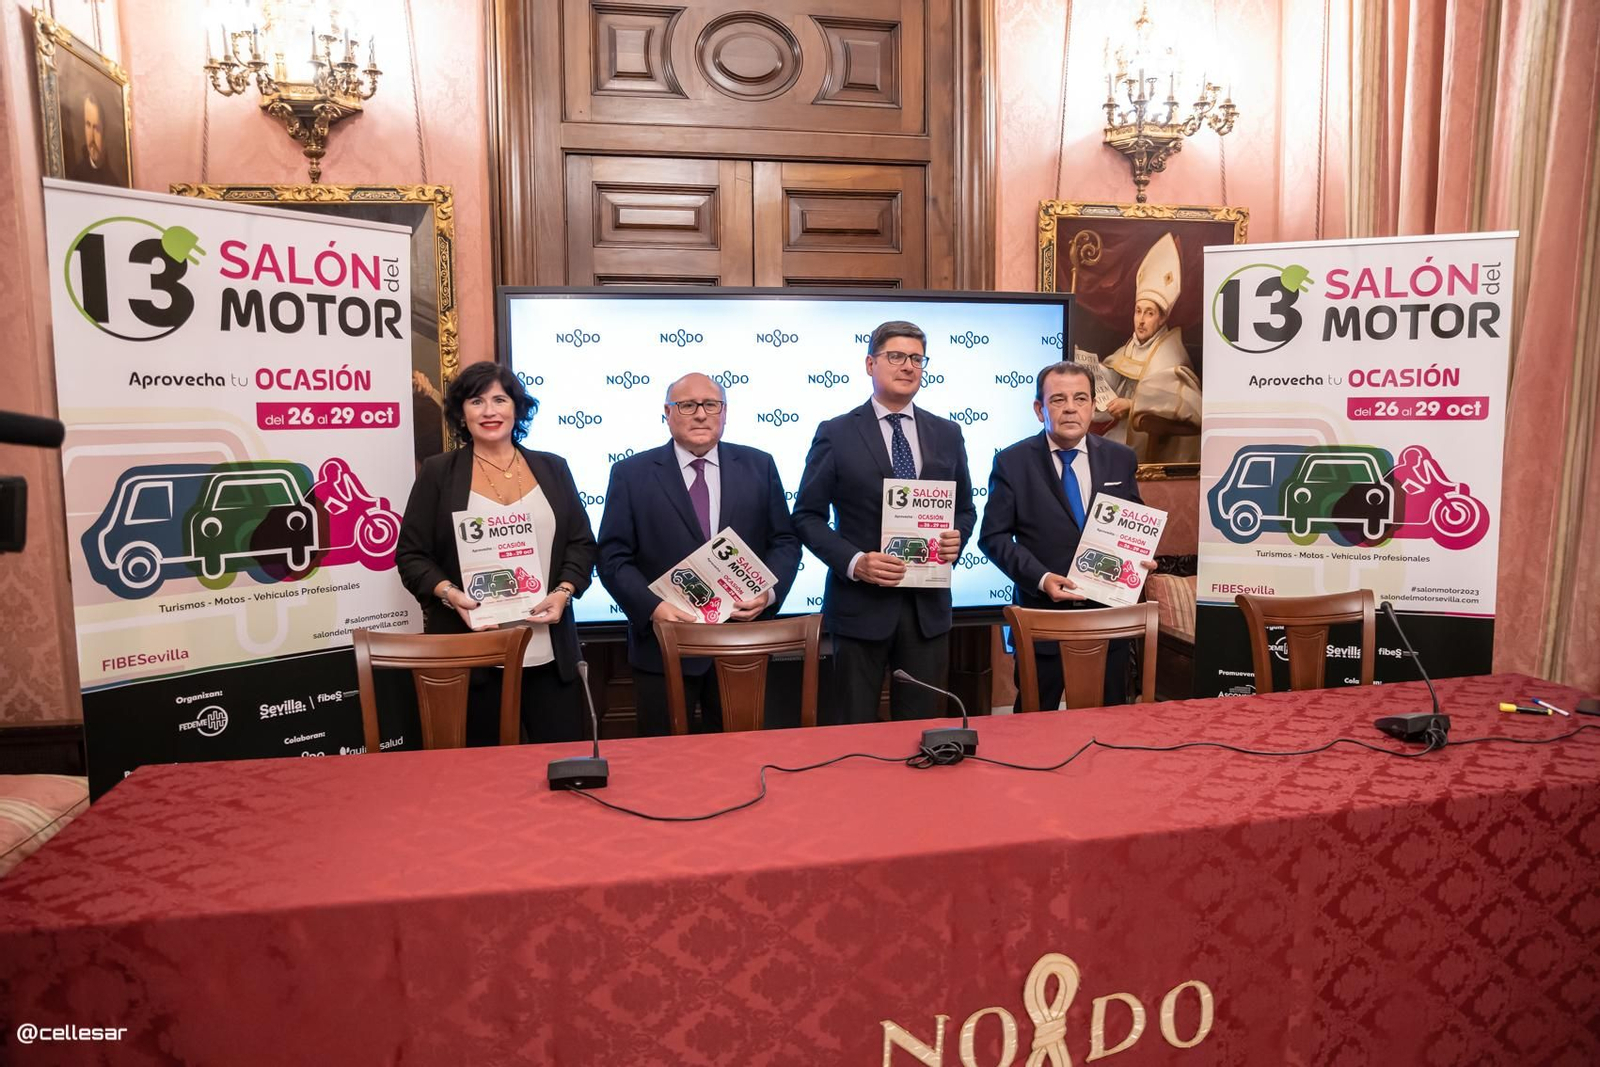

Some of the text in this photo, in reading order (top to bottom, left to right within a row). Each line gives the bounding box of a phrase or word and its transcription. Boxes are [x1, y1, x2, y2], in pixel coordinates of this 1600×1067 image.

[219, 240, 381, 290] SALÓN
[383, 257, 400, 293] del
[75, 233, 195, 327] 13
[1325, 256, 1479, 300] SALÓN
[1482, 261, 1501, 295] del
[220, 287, 403, 339] MOTOR
[1219, 276, 1303, 343] 13
[1322, 301, 1500, 341] MOTOR
[129, 363, 371, 391] Aprovecha tu OCASIÓN
[1249, 363, 1460, 388] Aprovecha tu OCASIÓN
[265, 406, 393, 425] del 26 al 29 oct
[1354, 401, 1481, 417] del 26 al 29 oct
[887, 488, 908, 507] 13
[912, 498, 953, 509] MOTOR
[913, 487, 949, 499] SALÓN
[488, 512, 526, 527] SALÓN
[1094, 502, 1115, 524] 13
[1121, 508, 1158, 526] SALÓN
[459, 520, 484, 541] 13
[489, 523, 532, 538] MOTOR
[1117, 518, 1159, 537] MOTOR
[711, 537, 735, 561] 13
[1256, 550, 1292, 559] Turismos
[1299, 551, 1324, 560] Motos
[1331, 552, 1372, 561] Vehículos
[1373, 553, 1430, 563] Profesionales
[728, 561, 761, 595] MOTOR
[736, 556, 766, 586] SALÓN
[159, 601, 206, 614] Turismos
[214, 595, 245, 607] Motos
[254, 587, 300, 601] Vehículos
[301, 581, 361, 596] Profesionales
[1211, 584, 1275, 595] FIBESevilla
[1380, 592, 1479, 604] salondelmotorsevilla.com
[1411, 586, 1480, 596] #salonmotor2023
[344, 610, 409, 624] #salonmotor2023
[102, 649, 189, 672] FIBESevilla
[175, 690, 223, 704] Organizan:
[284, 731, 326, 745] Colaboran:
